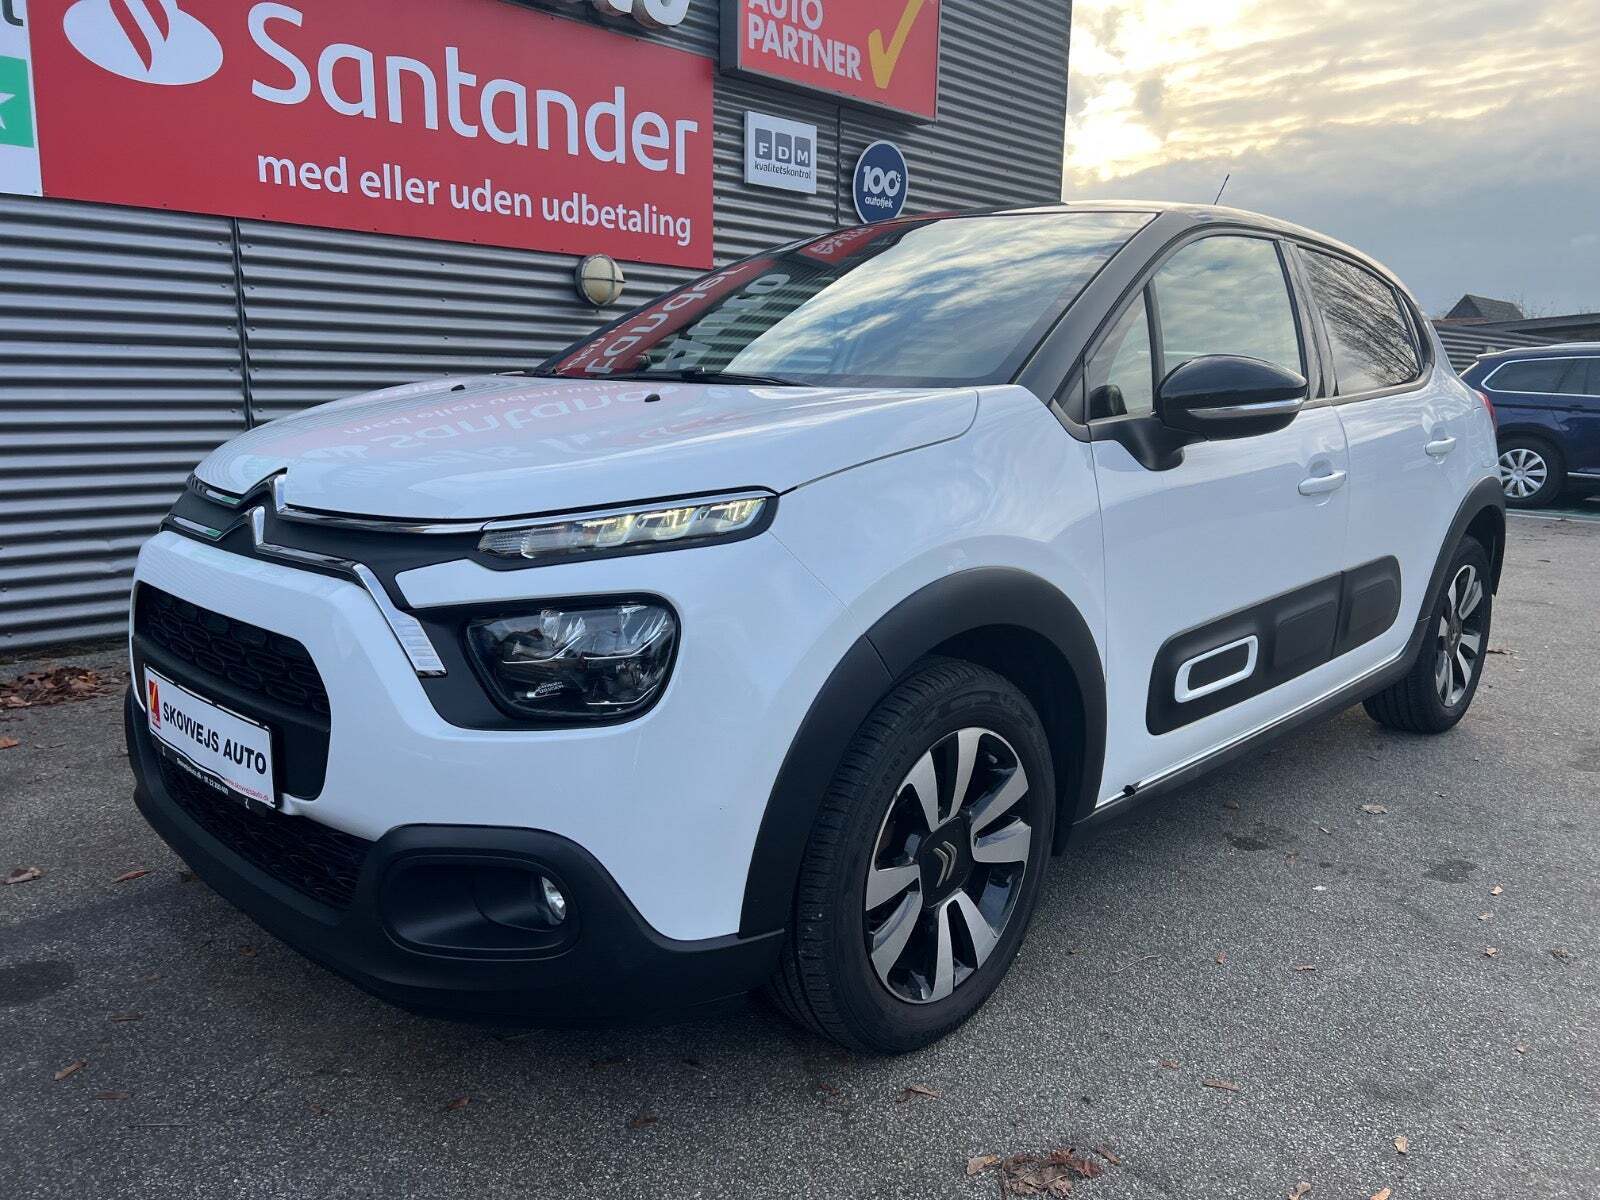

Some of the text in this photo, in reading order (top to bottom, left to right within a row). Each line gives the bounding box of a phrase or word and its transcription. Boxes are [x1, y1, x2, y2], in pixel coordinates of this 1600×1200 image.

[748, 13, 862, 81] PARTNER
[247, 2, 698, 175] Santander
[257, 154, 691, 247] med eller uden udbetaling
[754, 161, 811, 180] kvalitetskontrol
[163, 701, 267, 775] SKOVVEJS AUTO
